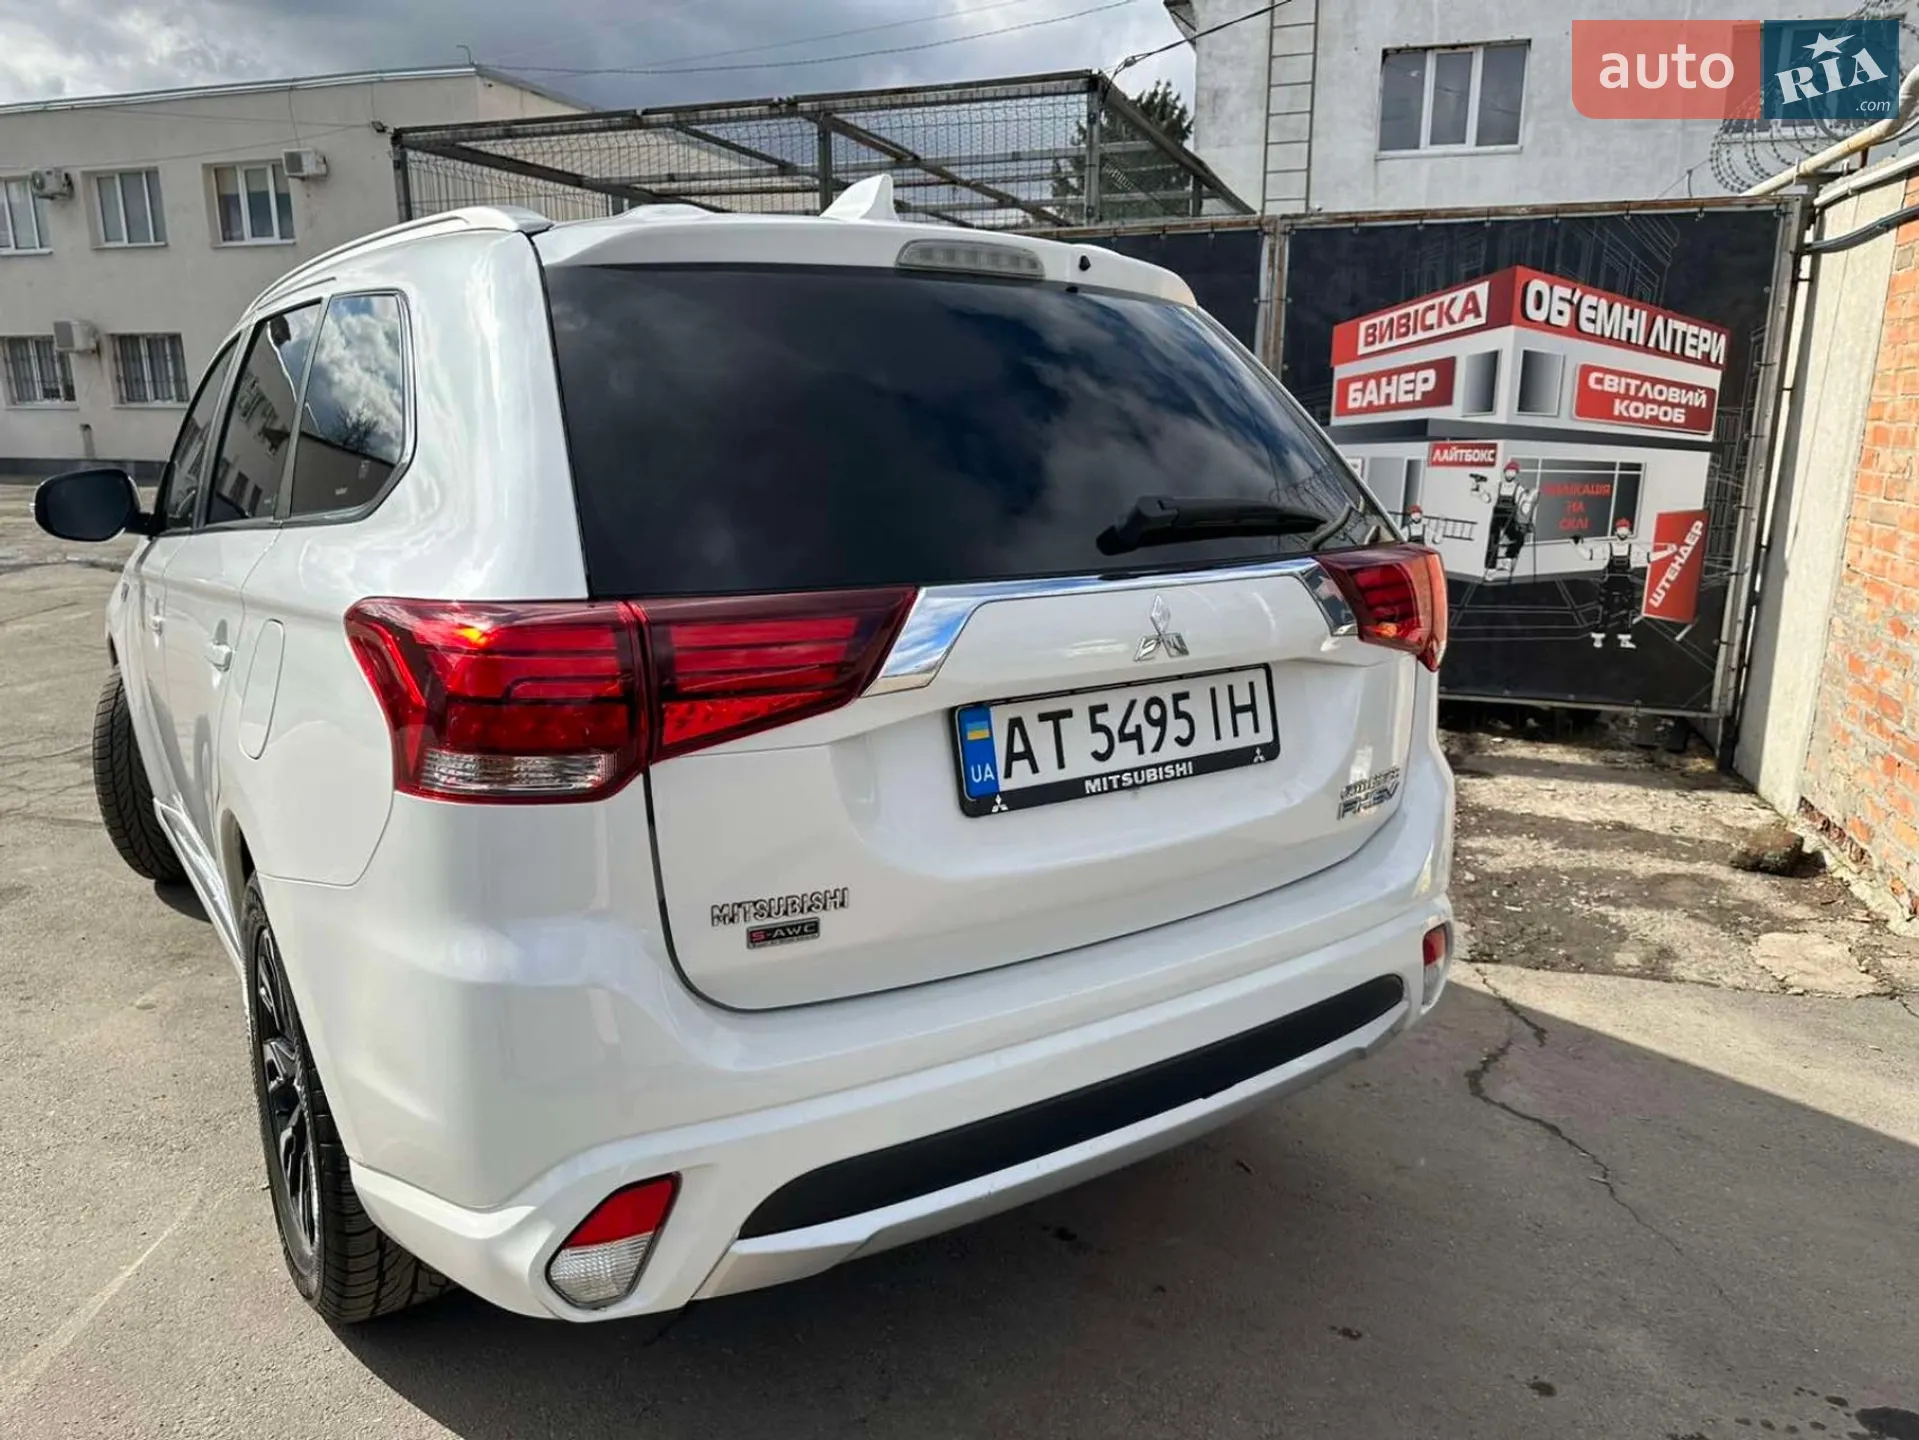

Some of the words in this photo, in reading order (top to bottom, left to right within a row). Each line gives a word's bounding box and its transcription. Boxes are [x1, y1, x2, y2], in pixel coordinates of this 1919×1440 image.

[1363, 290, 1482, 347] ВИВІСКА
[1525, 279, 1648, 345] ОБ'ЄМНІ
[1648, 315, 1726, 365] ЛІТЕРИ
[1347, 368, 1436, 409] БАНЕР
[1588, 372, 1707, 408] СВІТЛОВИЙ
[1613, 399, 1686, 424] КОРОБ
[1433, 446, 1495, 462] ЛАЙТБОКС
[1649, 520, 1703, 608] ШТЕНДЕР
[1004, 709, 1073, 780] AT
[1089, 690, 1196, 762] 5495
[1210, 681, 1260, 741] IH
[971, 765, 995, 784] UA
[1084, 760, 1194, 794] MITSUBISHI
[711, 887, 849, 926] MITSUBISHI
[751, 923, 817, 942] S-AWC
